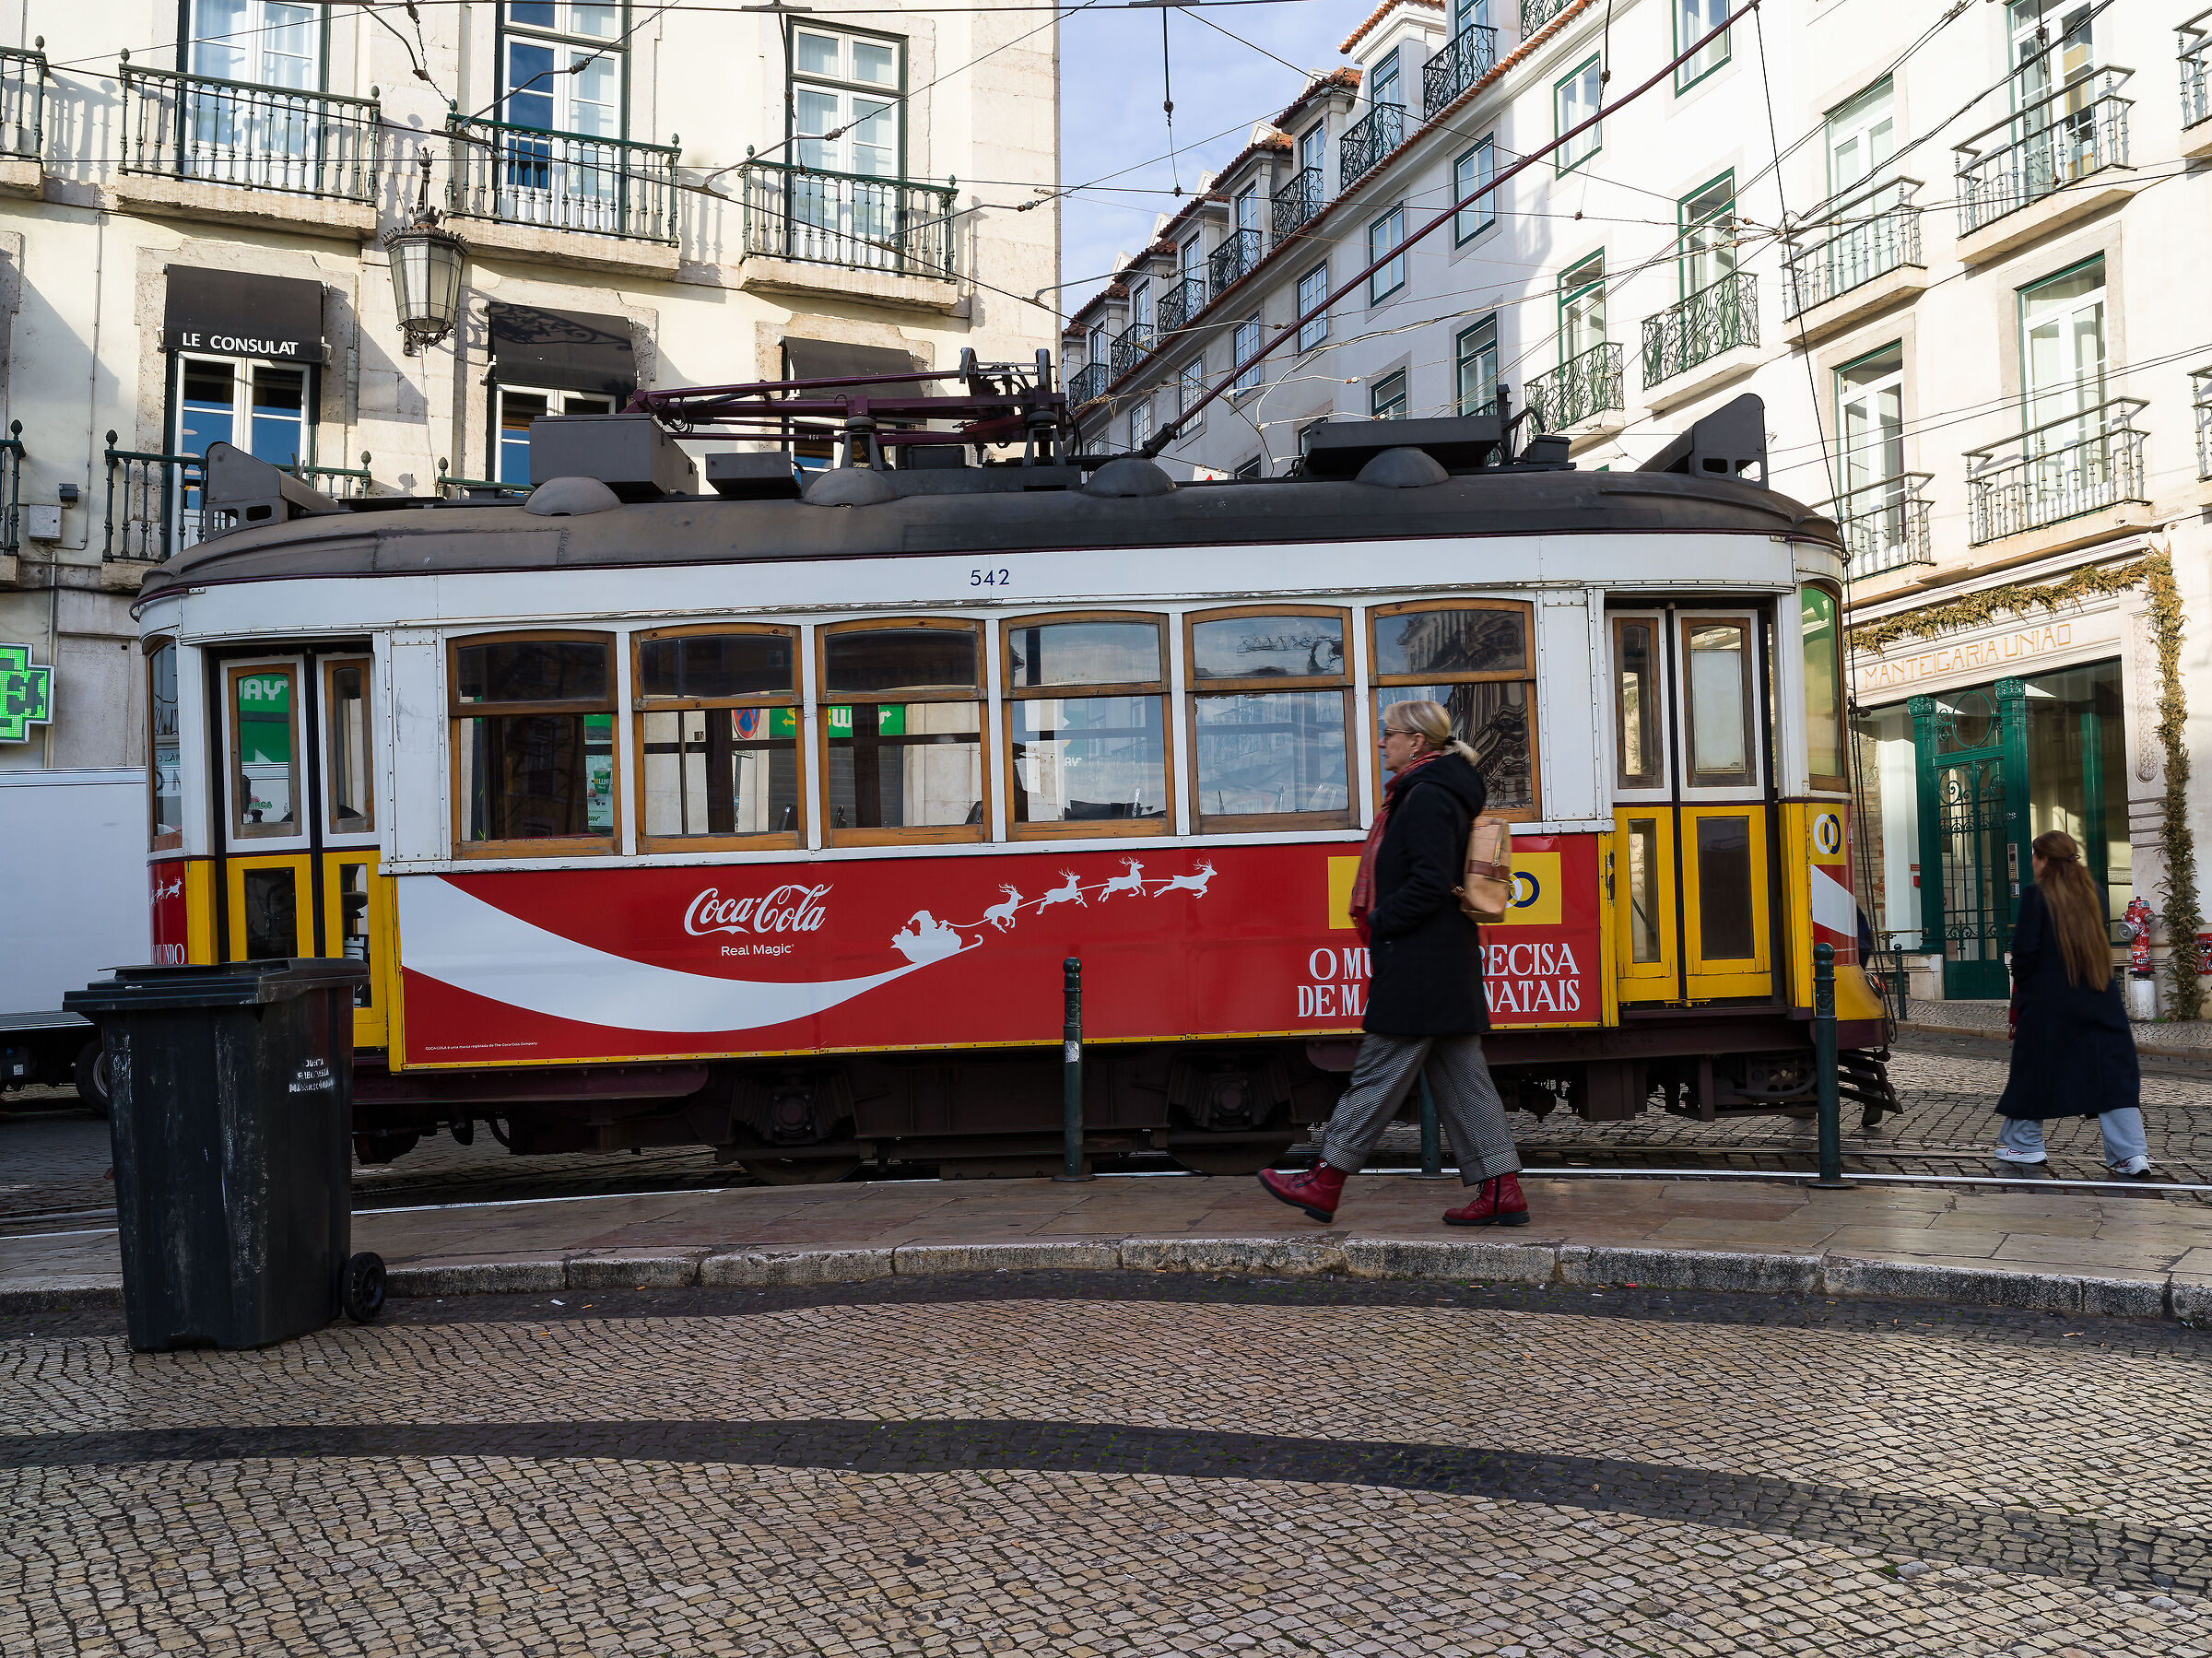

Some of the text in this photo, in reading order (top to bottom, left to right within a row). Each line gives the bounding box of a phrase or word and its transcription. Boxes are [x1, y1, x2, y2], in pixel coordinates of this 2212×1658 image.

[182, 332, 300, 356] LE CONSULAT
[970, 569, 1010, 586] 542
[1865, 623, 2072, 688] MANTEIGARIA UNIÃO
[684, 883, 834, 936] Coca-Cola
[722, 944, 792, 957] Real Magic
[1309, 948, 1337, 981] O
[1343, 947, 1374, 980] MU
[1298, 985, 1335, 1017] DE
